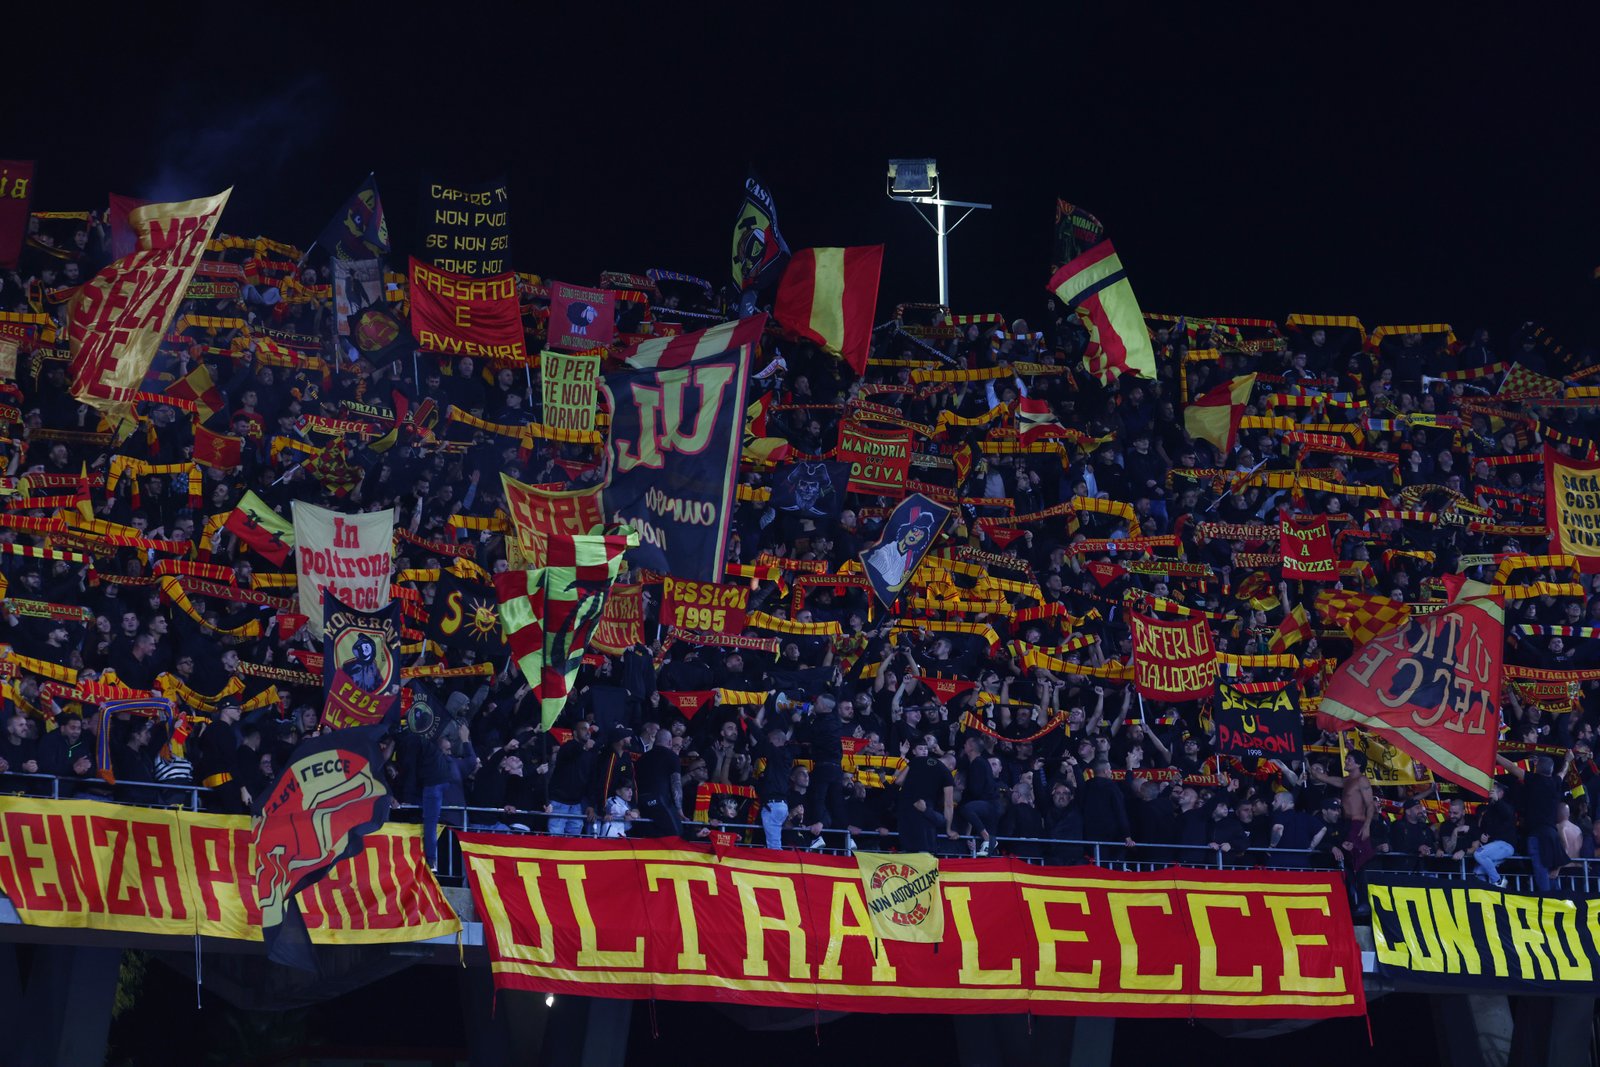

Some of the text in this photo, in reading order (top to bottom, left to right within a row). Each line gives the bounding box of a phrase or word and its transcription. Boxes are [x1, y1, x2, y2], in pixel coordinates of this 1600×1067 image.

[431, 184, 491, 206] CAPIRE
[435, 209, 469, 226] NON
[426, 233, 508, 250] SE NON SEI
[434, 258, 503, 274] COME NOI
[413, 265, 517, 300] PASSATO
[455, 306, 471, 327] E
[418, 331, 526, 361] AVVENIRE
[544, 356, 560, 379] IO
[563, 360, 596, 381] PER
[544, 380, 593, 406] TE NON
[333, 420, 370, 432] LECCE
[841, 437, 907, 459] MANDURIA
[332, 517, 360, 549] In
[1300, 544, 1311, 557] A
[1282, 555, 1334, 573] STOZZE
[239, 589, 291, 612] NORD
[662, 576, 750, 609] PESSIMI
[674, 605, 727, 633] 1995
[704, 634, 762, 649] PADRONI
[1132, 616, 1211, 661] INFERNO
[1503, 666, 1517, 677] LA
[1519, 667, 1579, 679] BATTAGLIA
[338, 682, 381, 713] FEDE
[1536, 684, 1566, 695] LECCE
[1218, 724, 1296, 754] PADRONI
[868, 868, 939, 916] NON AUTORIZZATO
[469, 855, 1346, 992] ULTRA LECCE
[892, 903, 928, 925] LECCE
[1367, 883, 1594, 981] CONTRO
